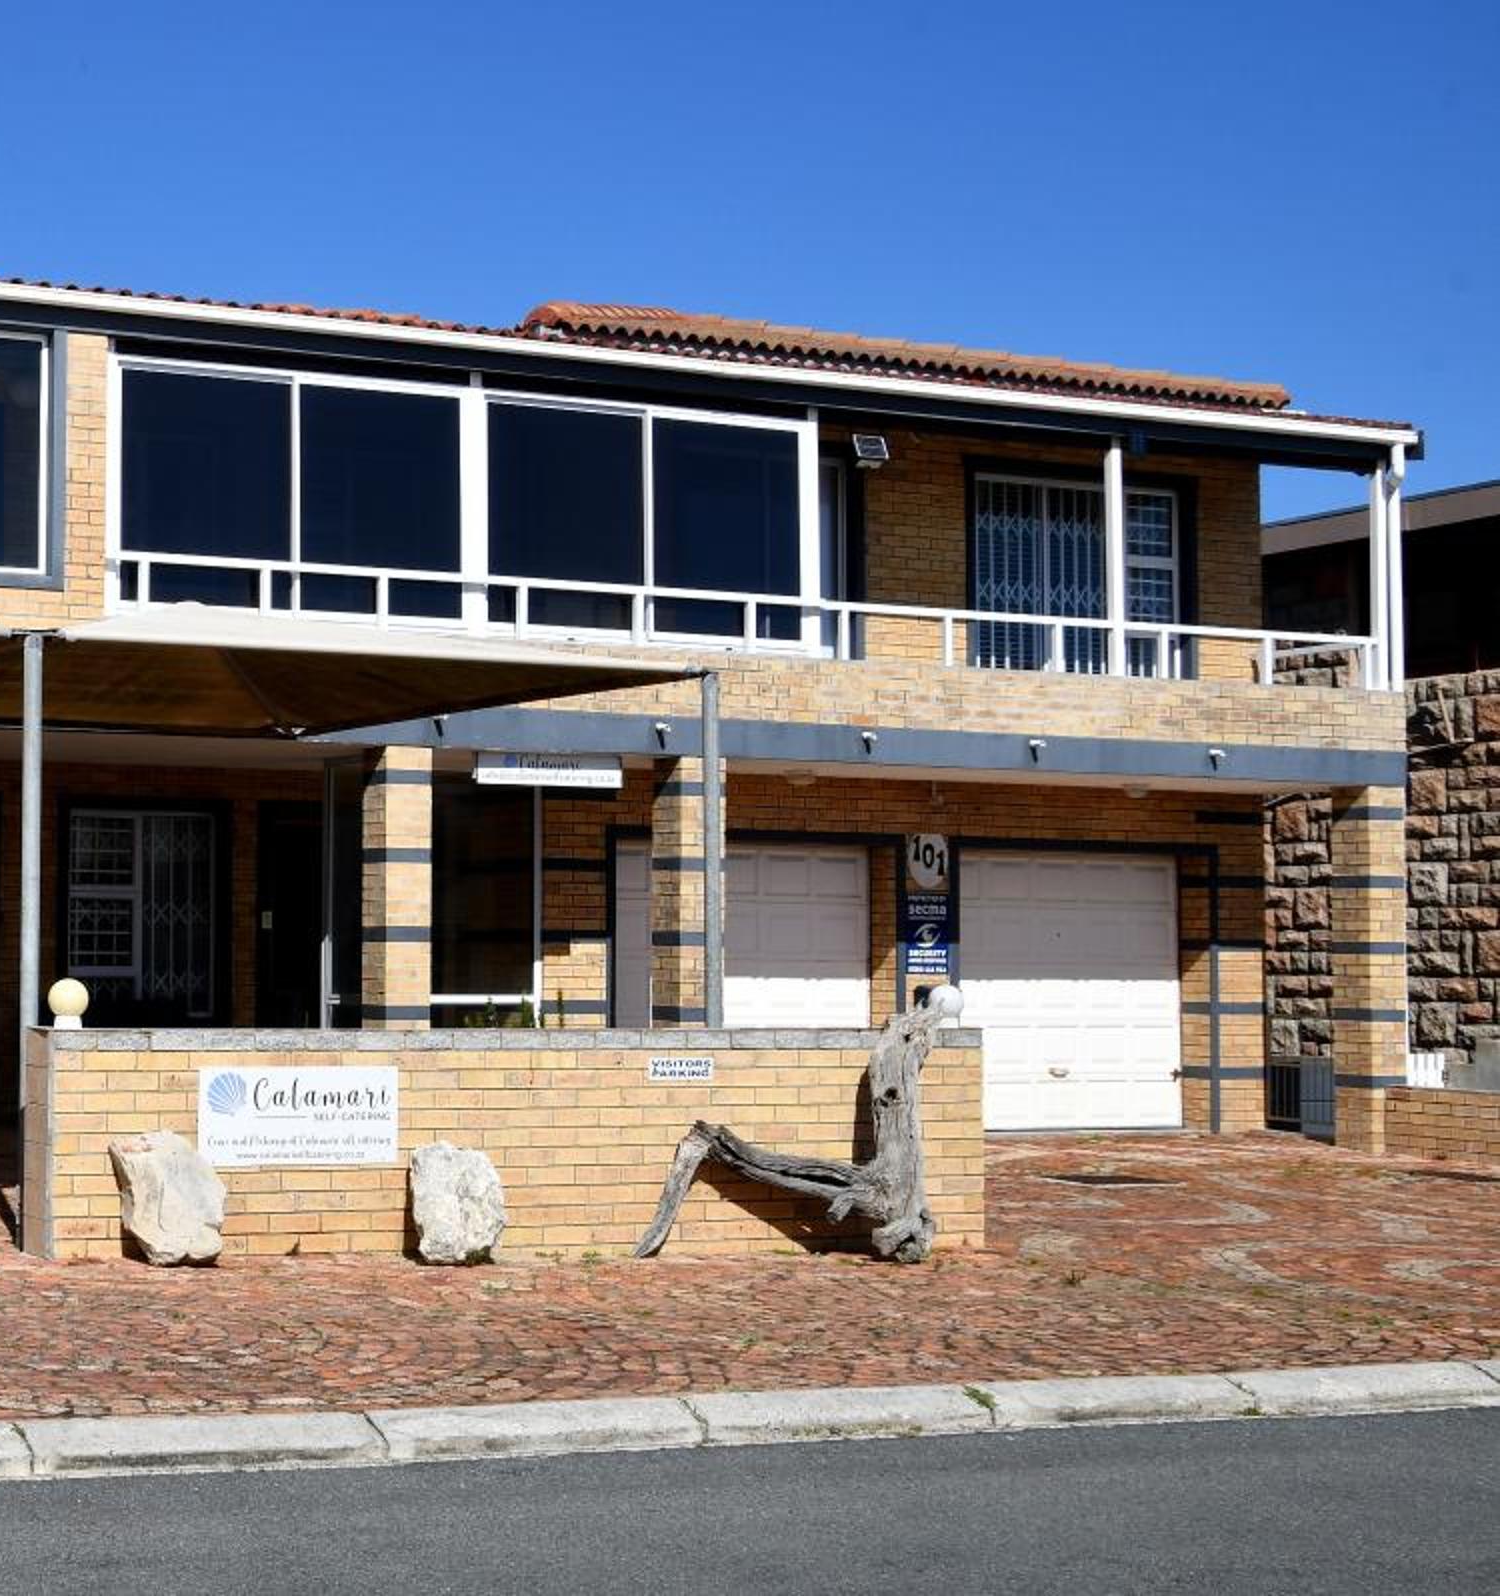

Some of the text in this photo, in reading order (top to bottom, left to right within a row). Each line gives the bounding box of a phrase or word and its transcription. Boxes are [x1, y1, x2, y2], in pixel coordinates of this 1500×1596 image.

[913, 835, 945, 876] 101
[652, 1060, 711, 1068] VISITORS
[652, 1068, 709, 1077] PARKING
[253, 1077, 391, 1112] Calamari
[313, 1112, 391, 1121] SELF-CATERING
